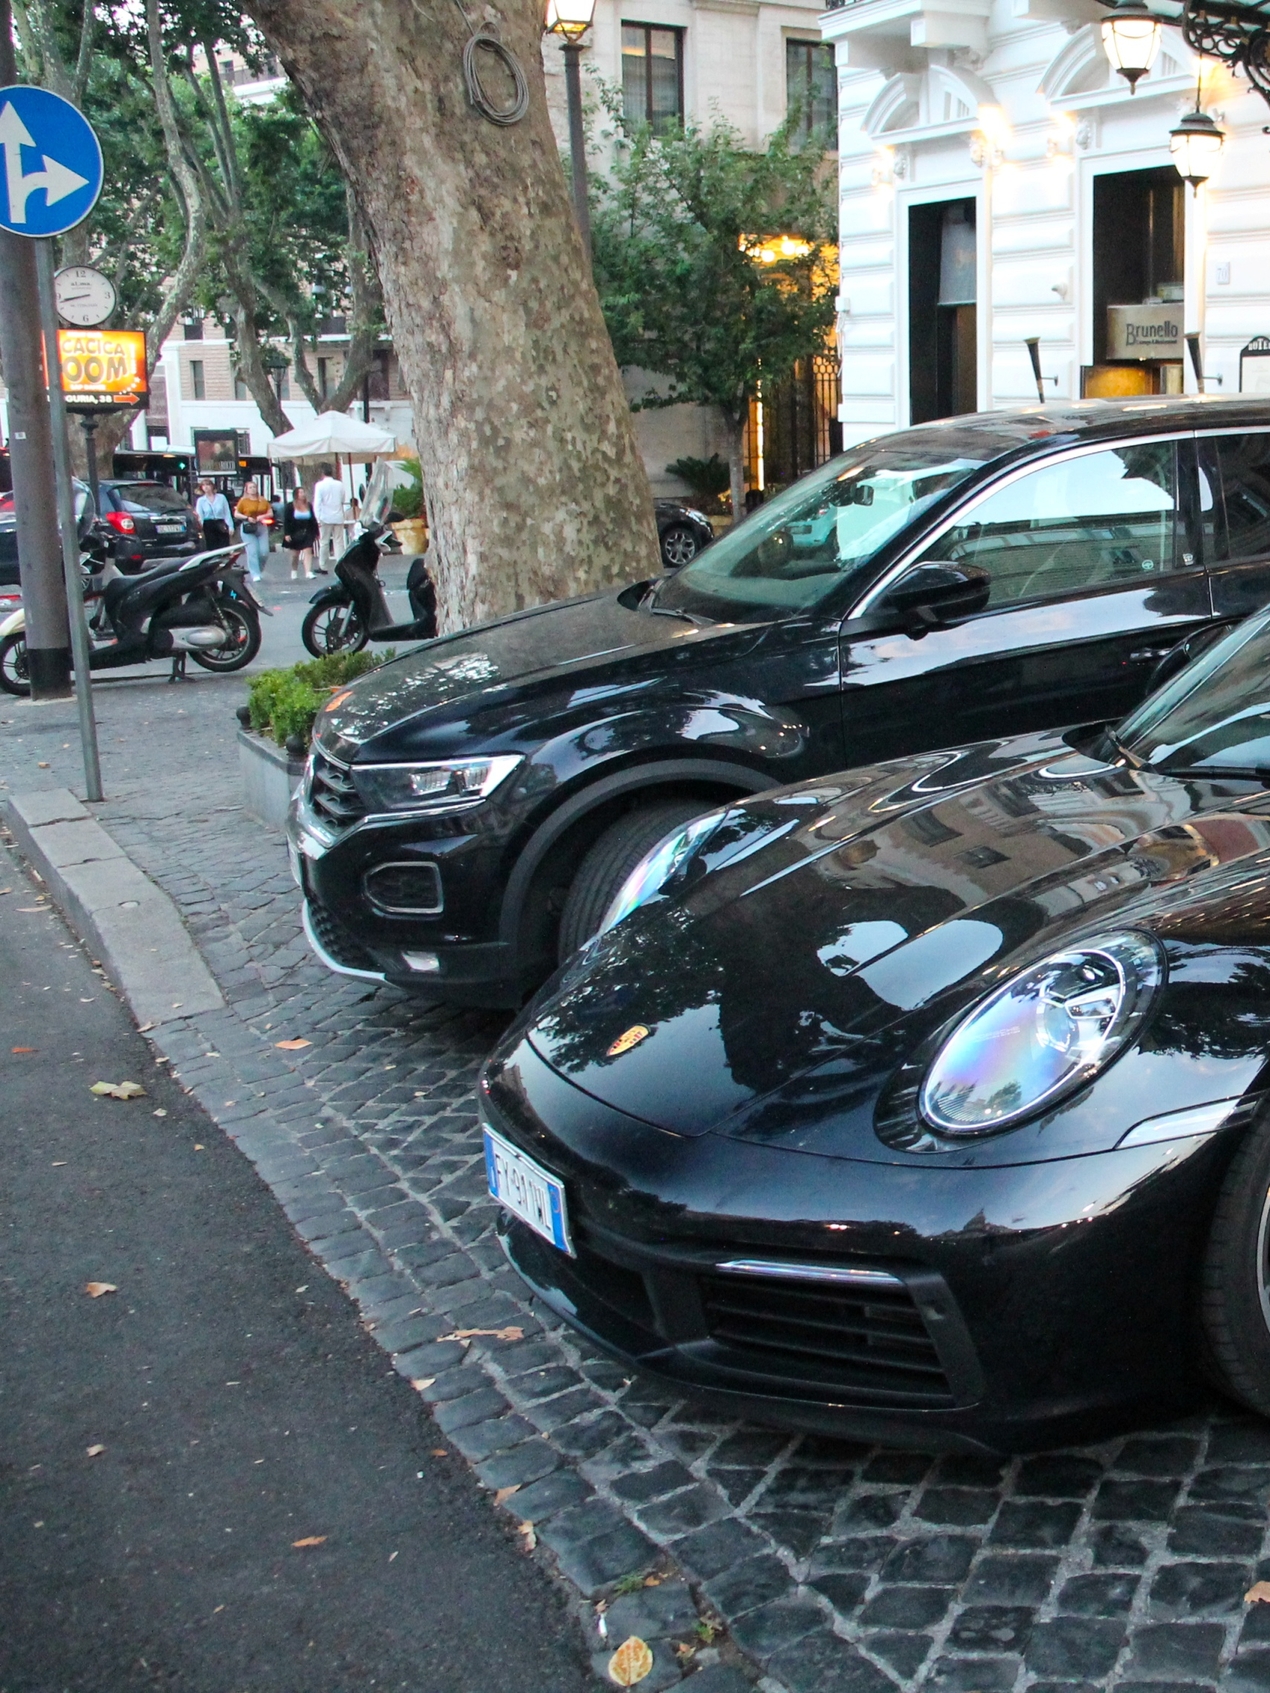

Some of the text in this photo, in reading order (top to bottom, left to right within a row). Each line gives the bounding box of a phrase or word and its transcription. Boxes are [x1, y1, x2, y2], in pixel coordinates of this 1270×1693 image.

[75, 270, 87, 278] 12
[82, 314, 89, 322] 6
[1125, 320, 1179, 347] Brunello
[61, 355, 129, 384] OOM
[99, 395, 112, 403] 38
